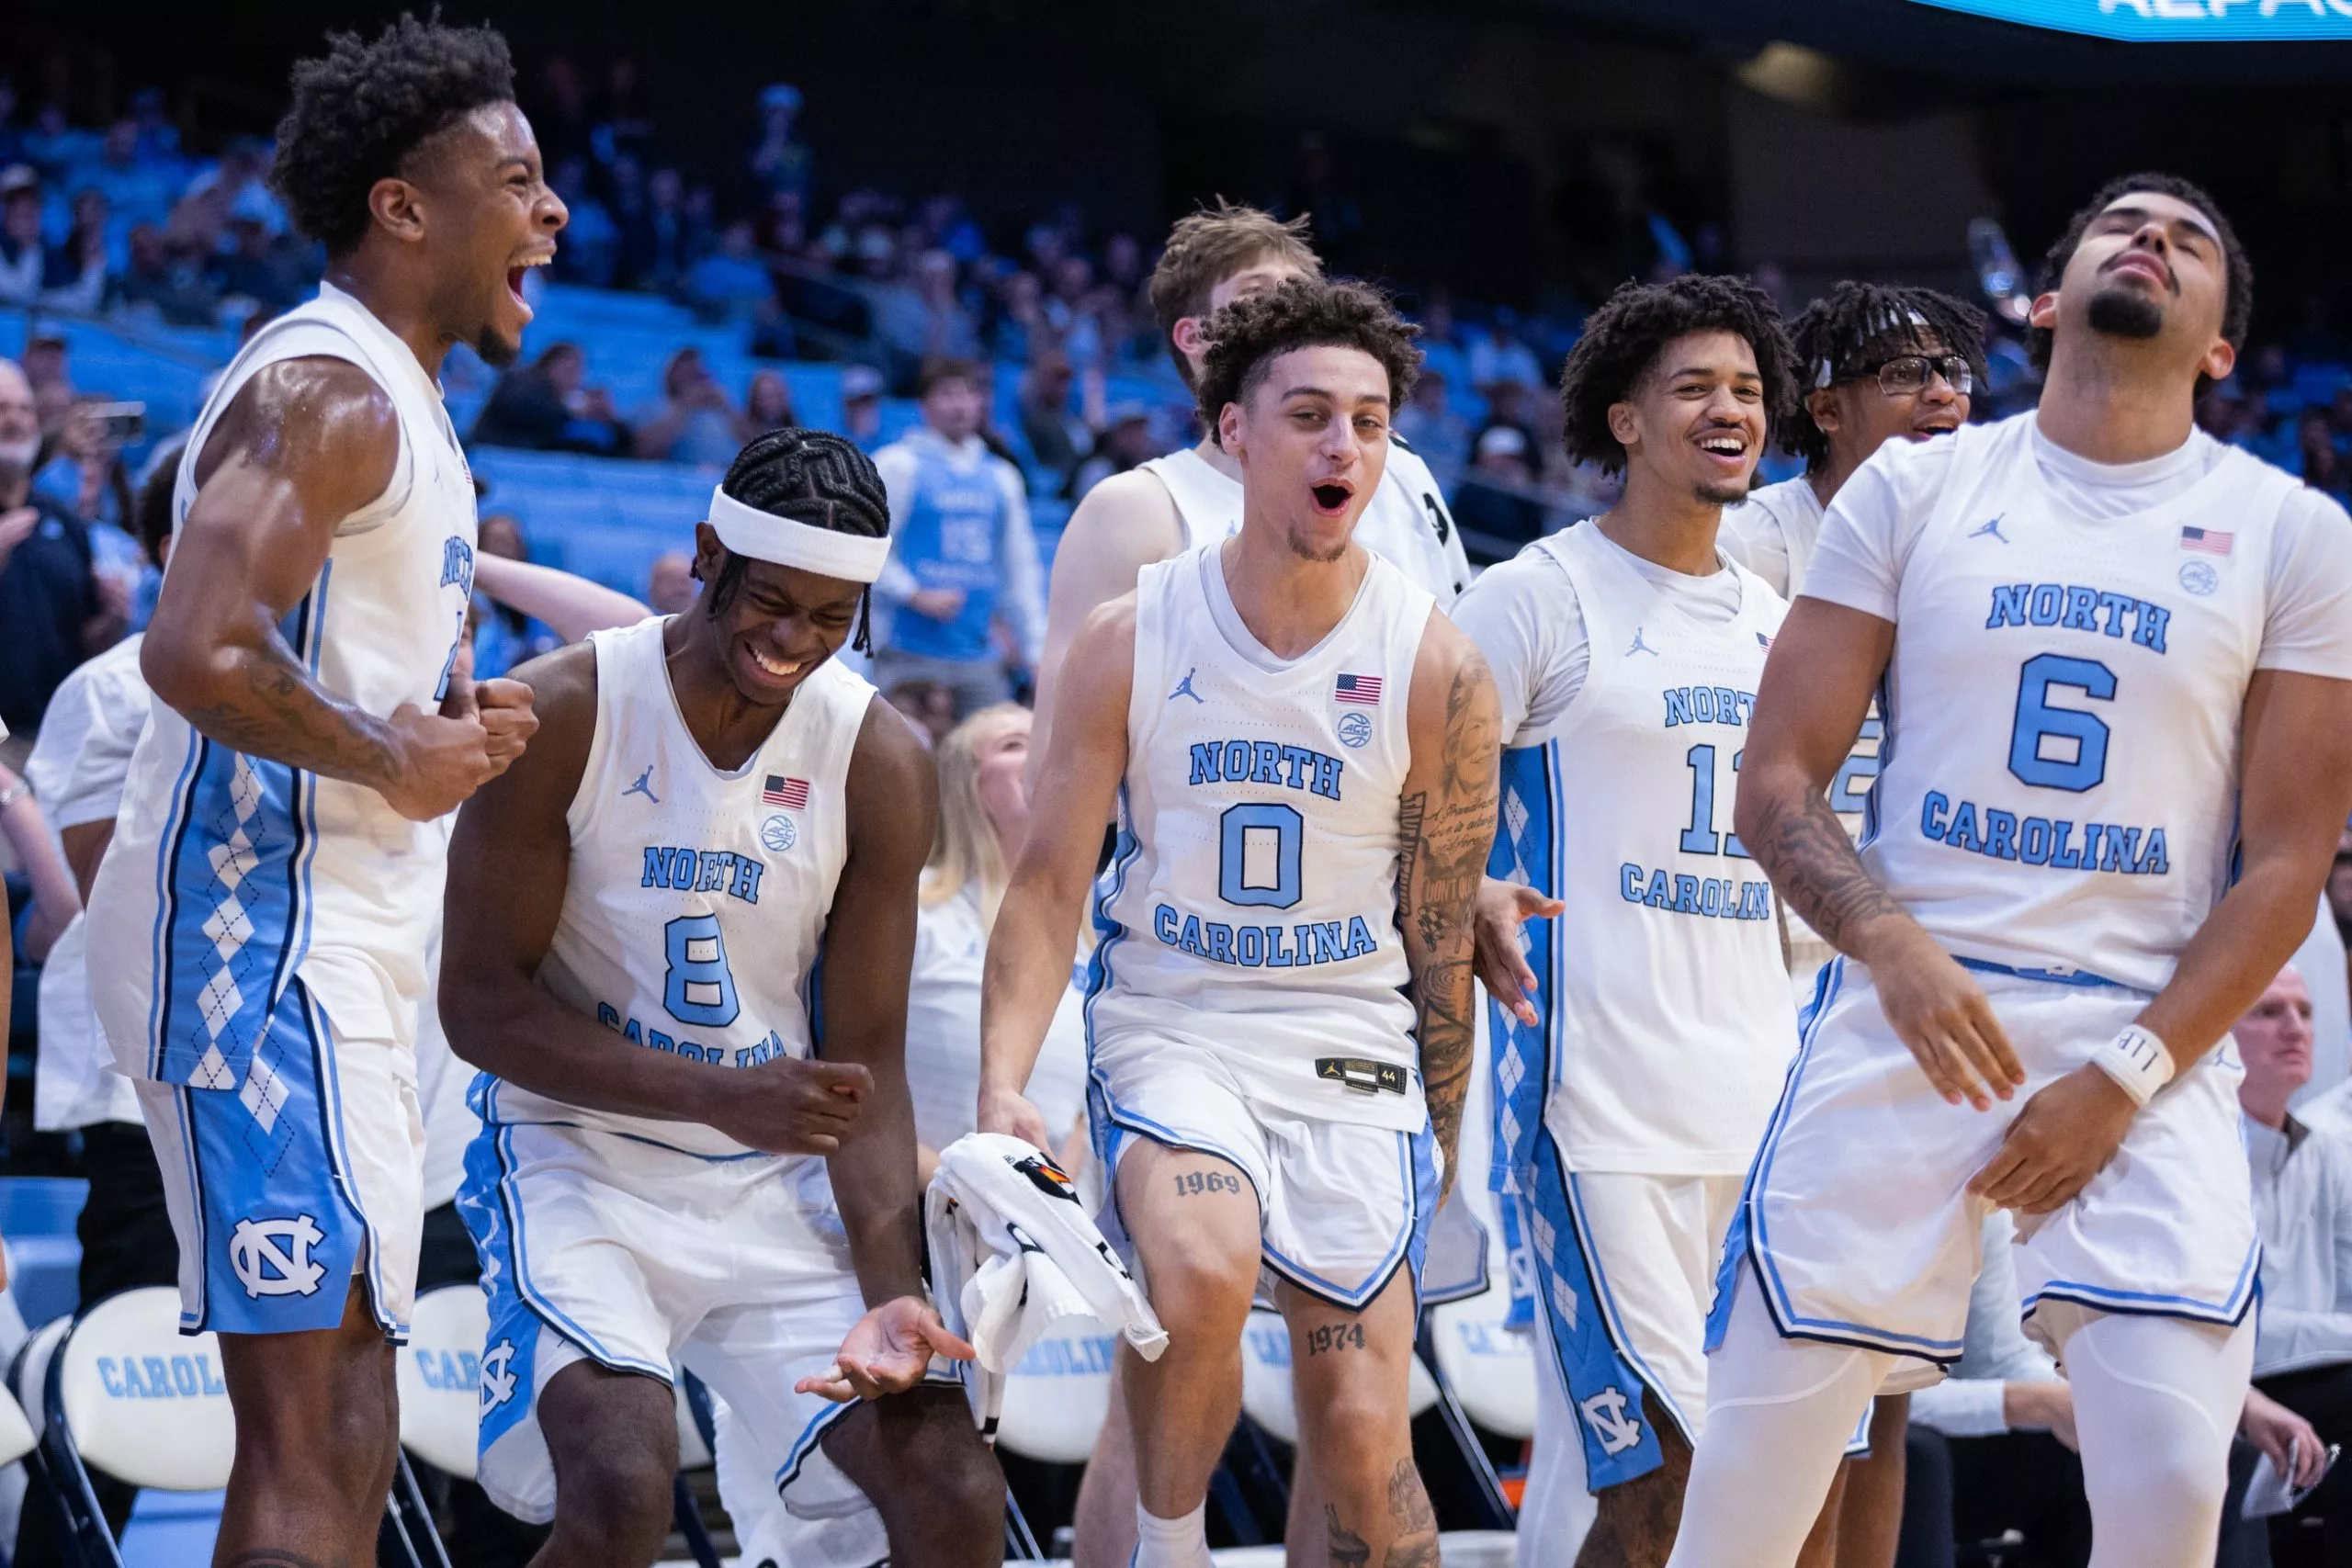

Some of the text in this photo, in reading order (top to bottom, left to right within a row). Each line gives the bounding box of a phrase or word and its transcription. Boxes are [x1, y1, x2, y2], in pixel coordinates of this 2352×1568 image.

[1985, 584, 2171, 654] NORTH
[1664, 686, 1758, 728] NORT
[2007, 653, 2118, 793] 6
[1189, 740, 1343, 801] NORTH
[1219, 803, 1303, 909] 0
[1920, 790, 2169, 874] CAROLINA
[641, 847, 764, 905] NORTH
[1621, 863, 1770, 920] CAROLIN
[1155, 904, 1377, 968] CAROLINA
[663, 913, 741, 1027] 8
[1381, 1070, 1396, 1082] 44
[1174, 1171, 1240, 1196] 1969
[1307, 1323, 1365, 1357] 1974
[97, 1354, 226, 1399] CAROL
